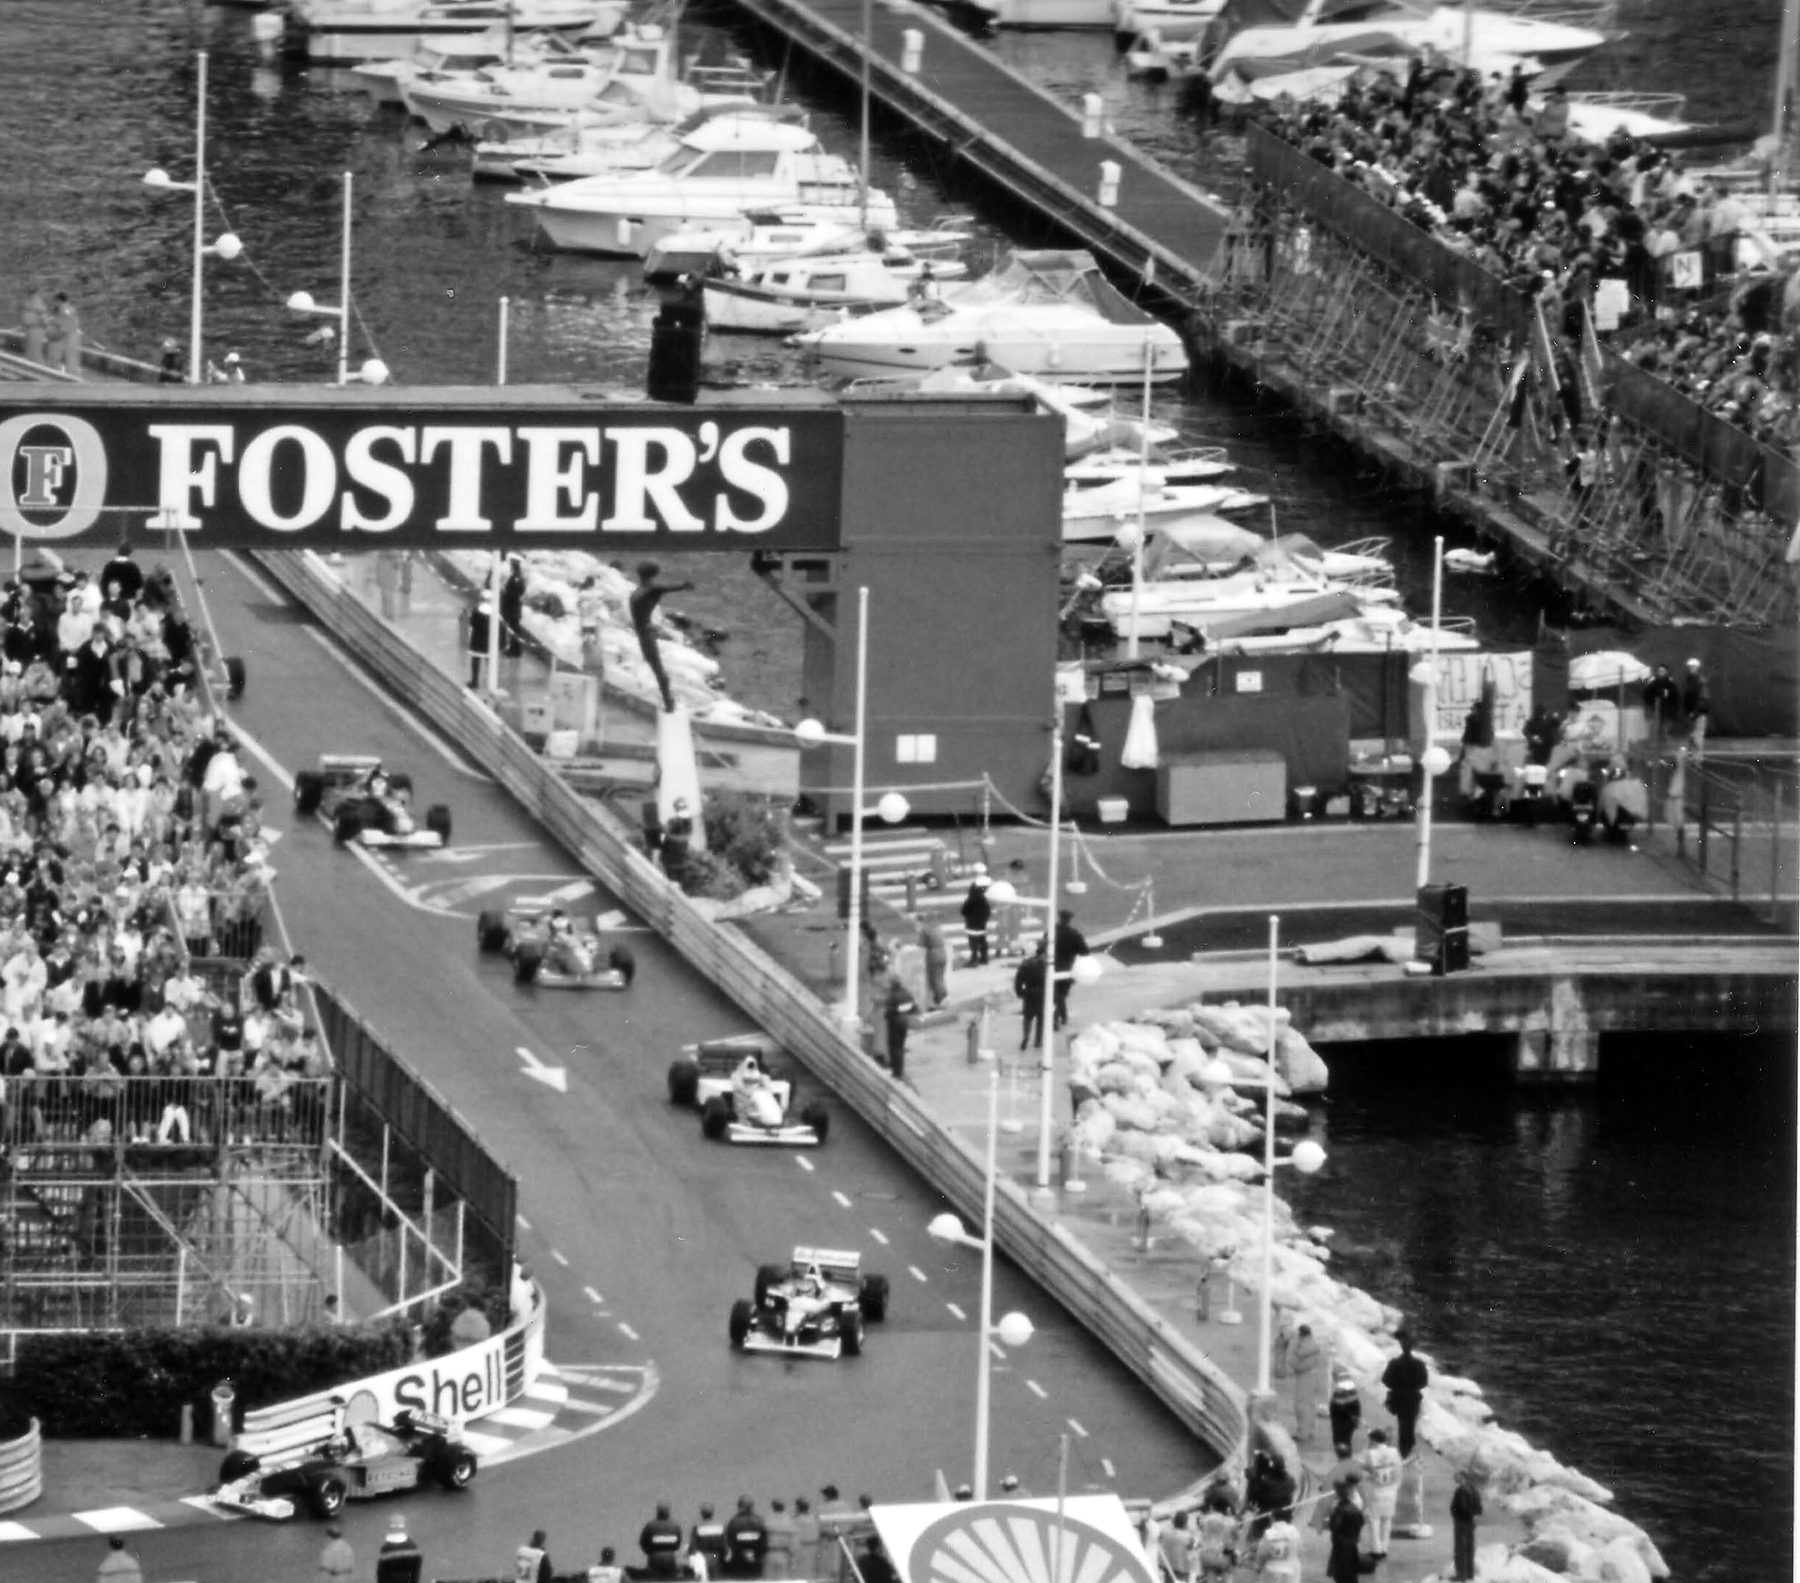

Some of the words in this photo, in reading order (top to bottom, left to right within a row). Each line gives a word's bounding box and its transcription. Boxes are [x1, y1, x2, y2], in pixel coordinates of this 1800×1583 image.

[19, 446, 72, 505] F
[145, 421, 792, 533] FOSTER'S
[395, 1349, 502, 1416] Shell
